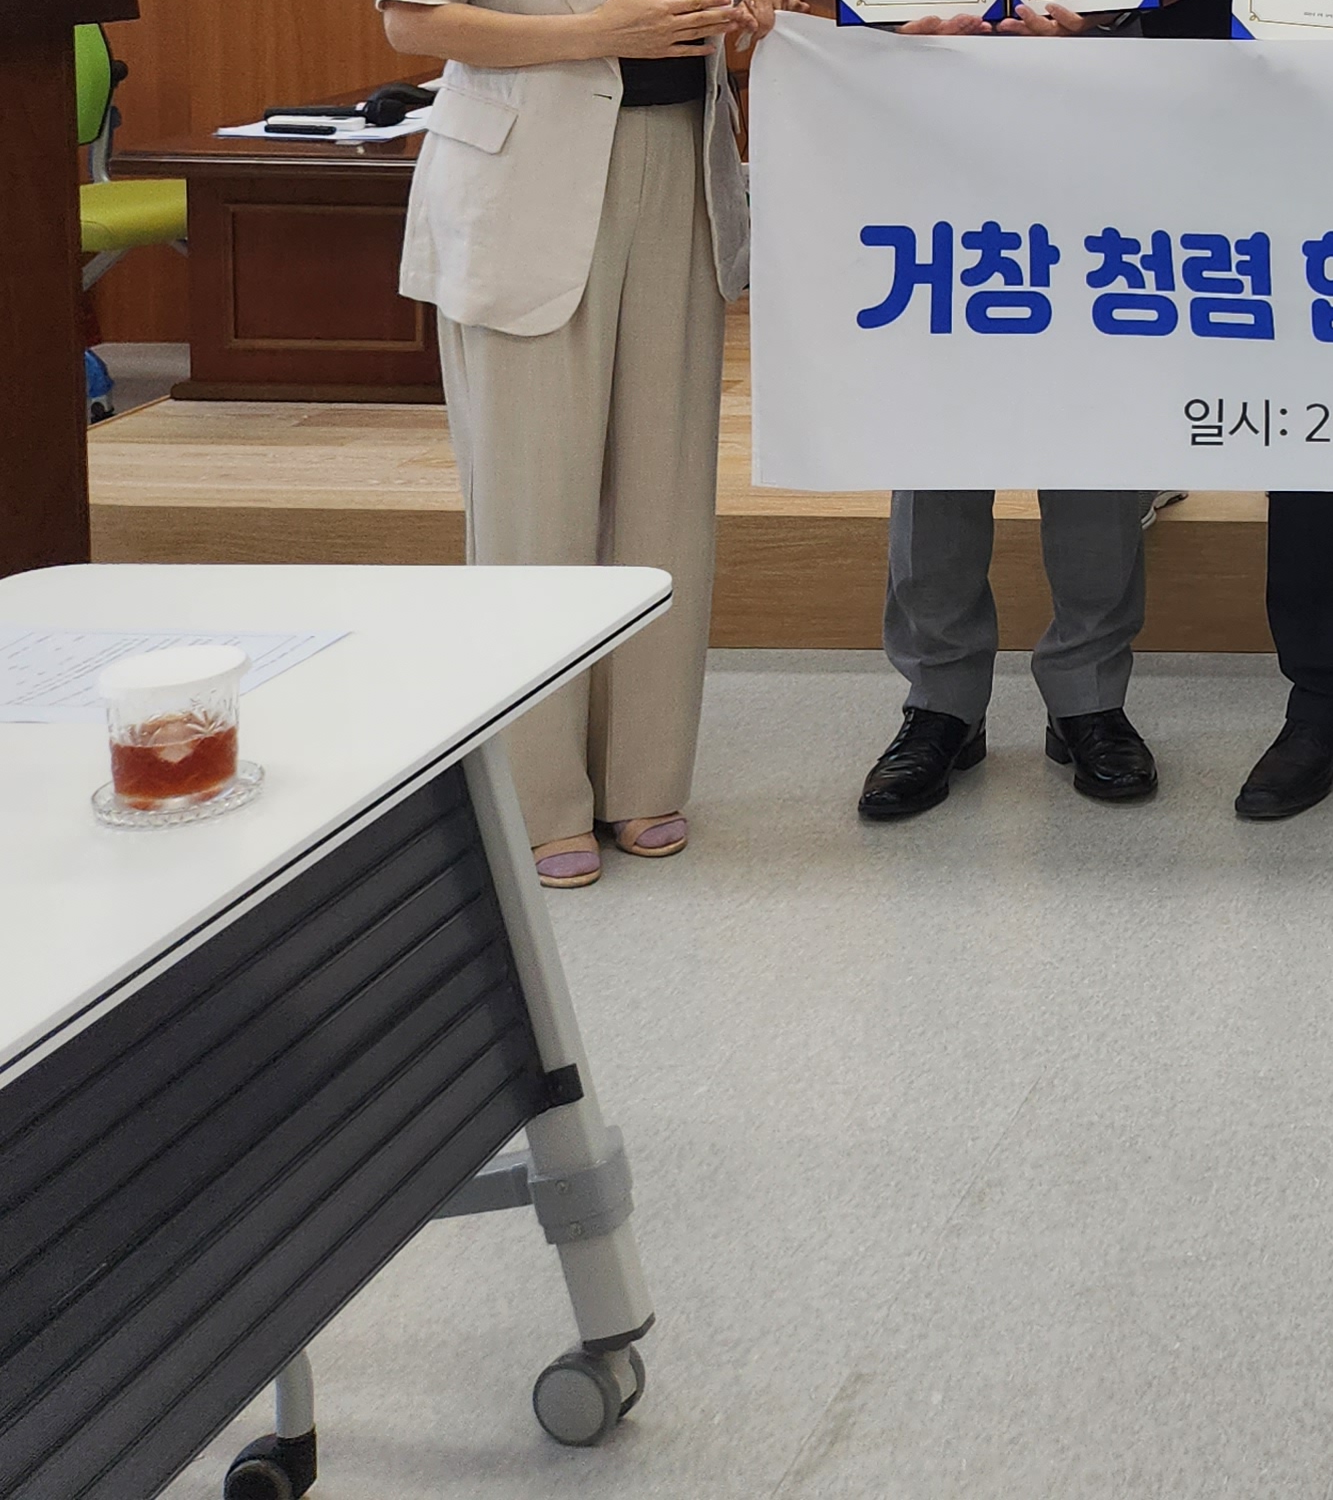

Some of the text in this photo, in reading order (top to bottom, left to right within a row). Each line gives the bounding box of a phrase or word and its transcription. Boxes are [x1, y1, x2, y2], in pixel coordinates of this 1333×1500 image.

[857, 221, 1061, 336] 거창
[1084, 227, 1275, 341] 청렴
[1184, 398, 1288, 447] 일시:
